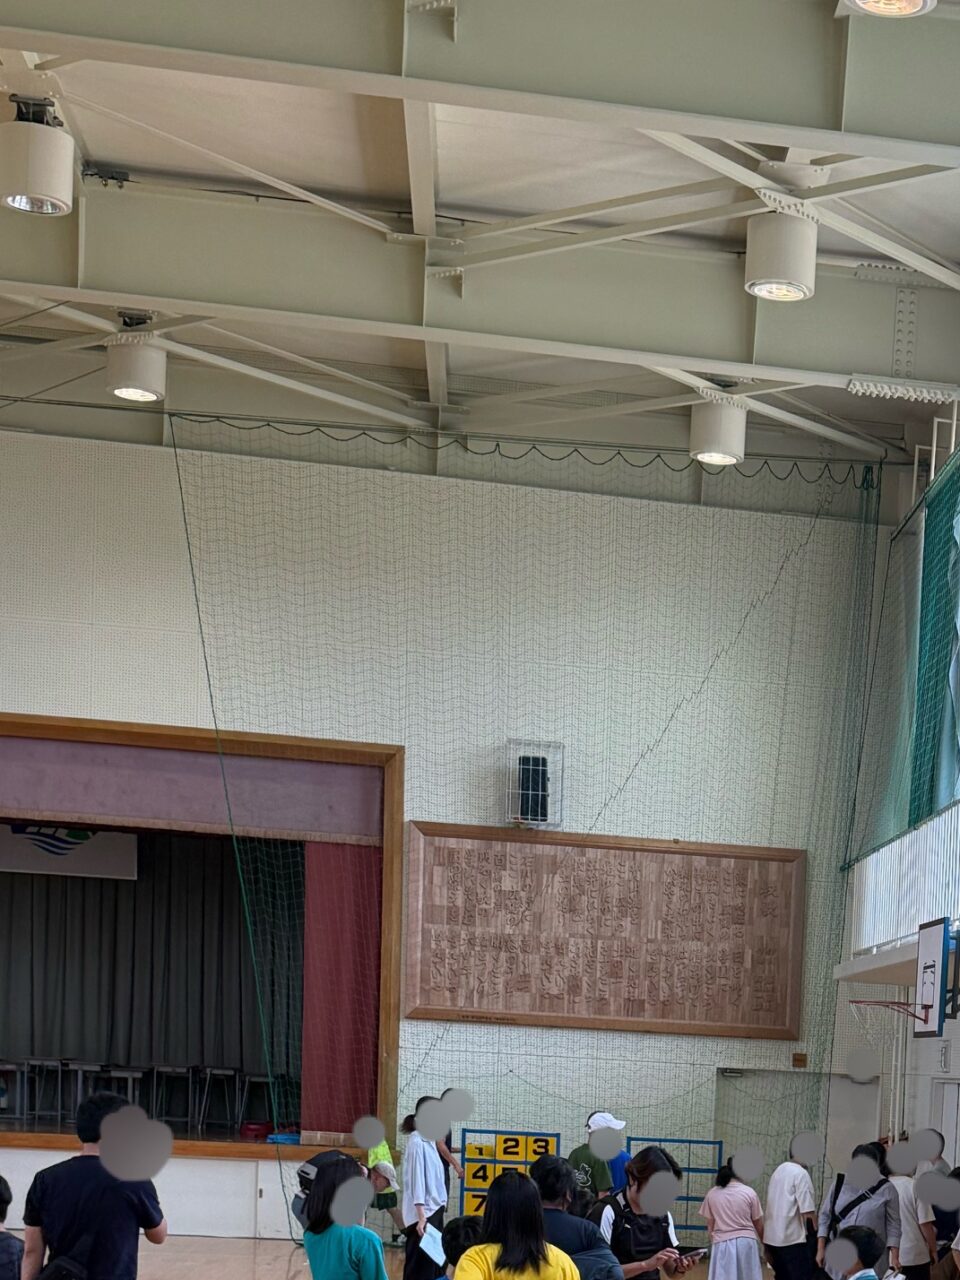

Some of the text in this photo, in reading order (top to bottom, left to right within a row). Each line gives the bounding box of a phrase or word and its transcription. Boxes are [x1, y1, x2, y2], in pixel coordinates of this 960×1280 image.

[503, 1137, 520, 1156] 2
[532, 1138, 549, 1156] 3
[472, 1164, 489, 1183] 4
[471, 1194, 487, 1212] 7
